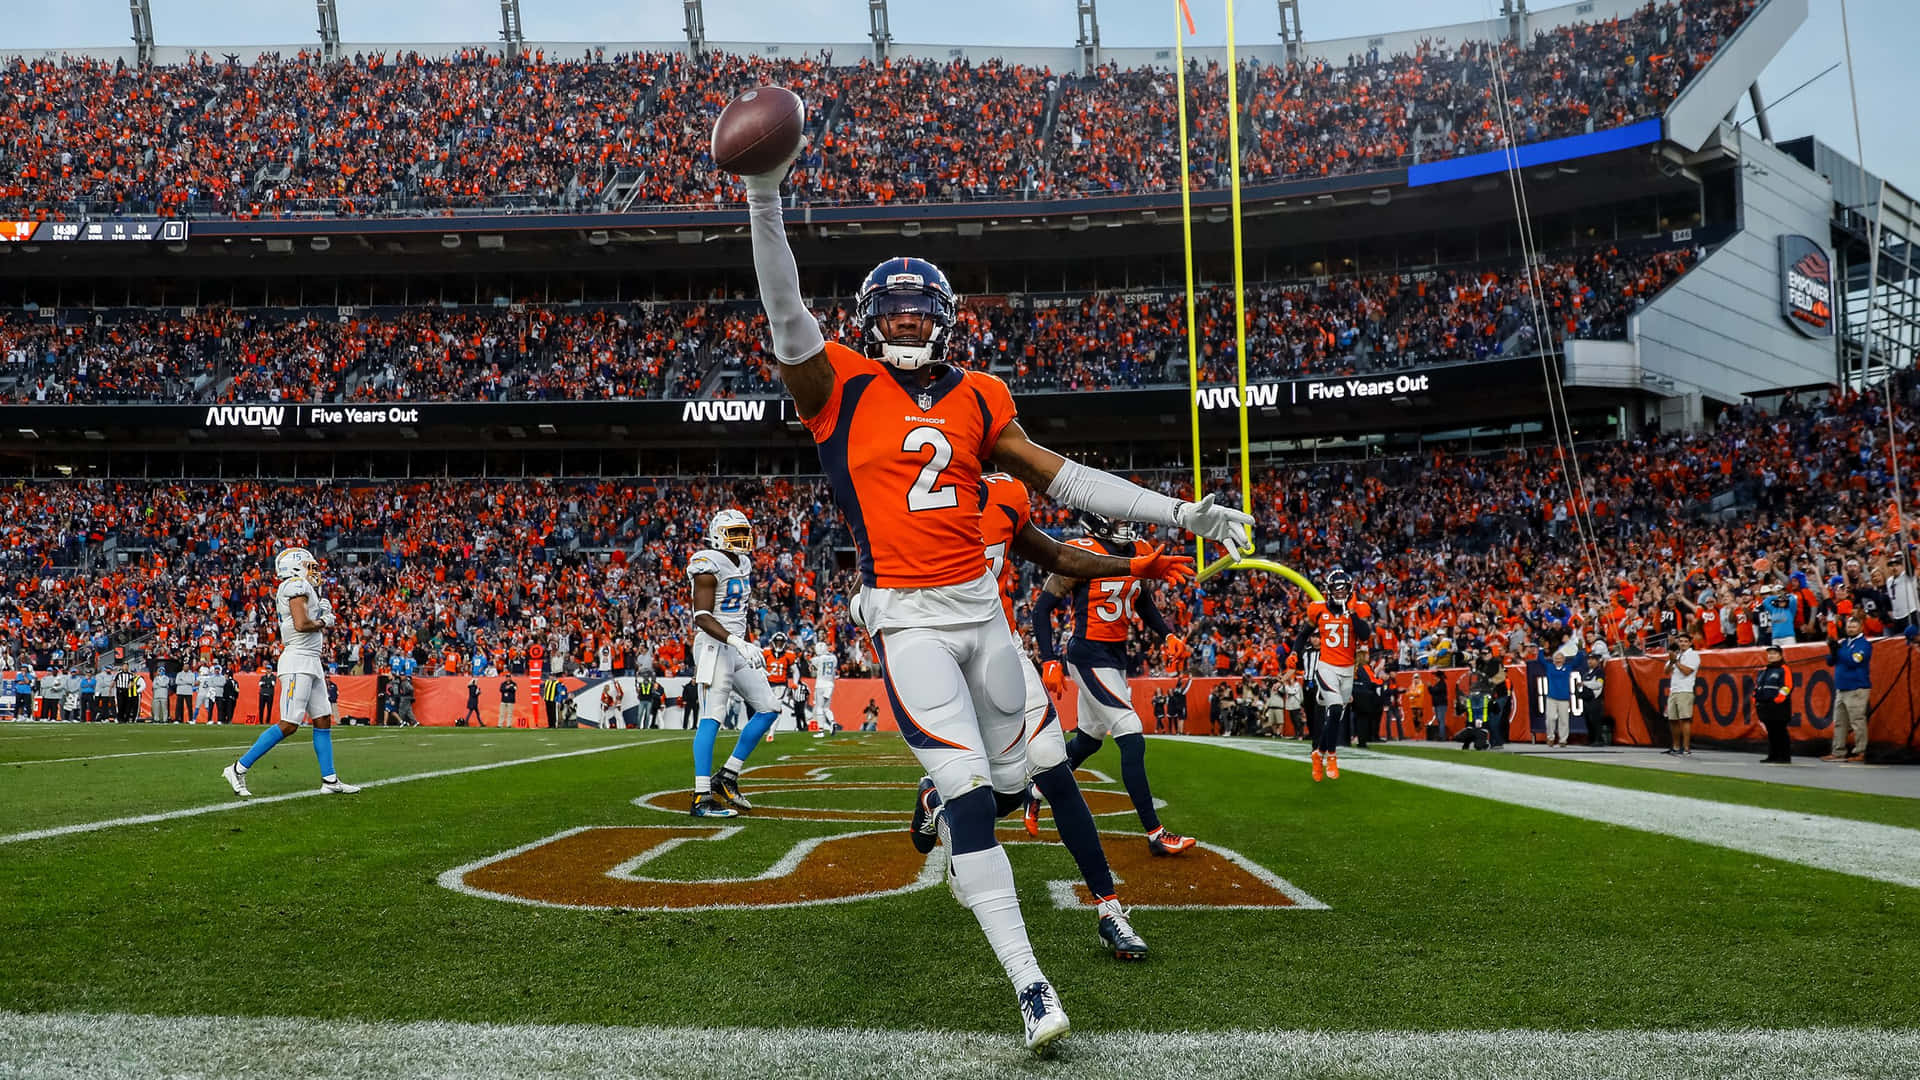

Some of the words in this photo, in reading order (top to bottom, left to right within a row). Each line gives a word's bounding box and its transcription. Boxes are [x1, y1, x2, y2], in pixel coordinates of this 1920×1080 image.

[15, 223, 29, 236] 14
[1308, 382, 1345, 400] Five
[1346, 380, 1394, 397] Years
[1395, 375, 1429, 392] Out
[206, 406, 285, 426] ARROW
[311, 408, 343, 423] Five
[344, 409, 386, 423] Years
[388, 407, 419, 423] Out
[682, 400, 766, 422] ARROW
[902, 425, 959, 513] 2
[1324, 623, 1350, 649] 31
[770, 661, 784, 676] 21
